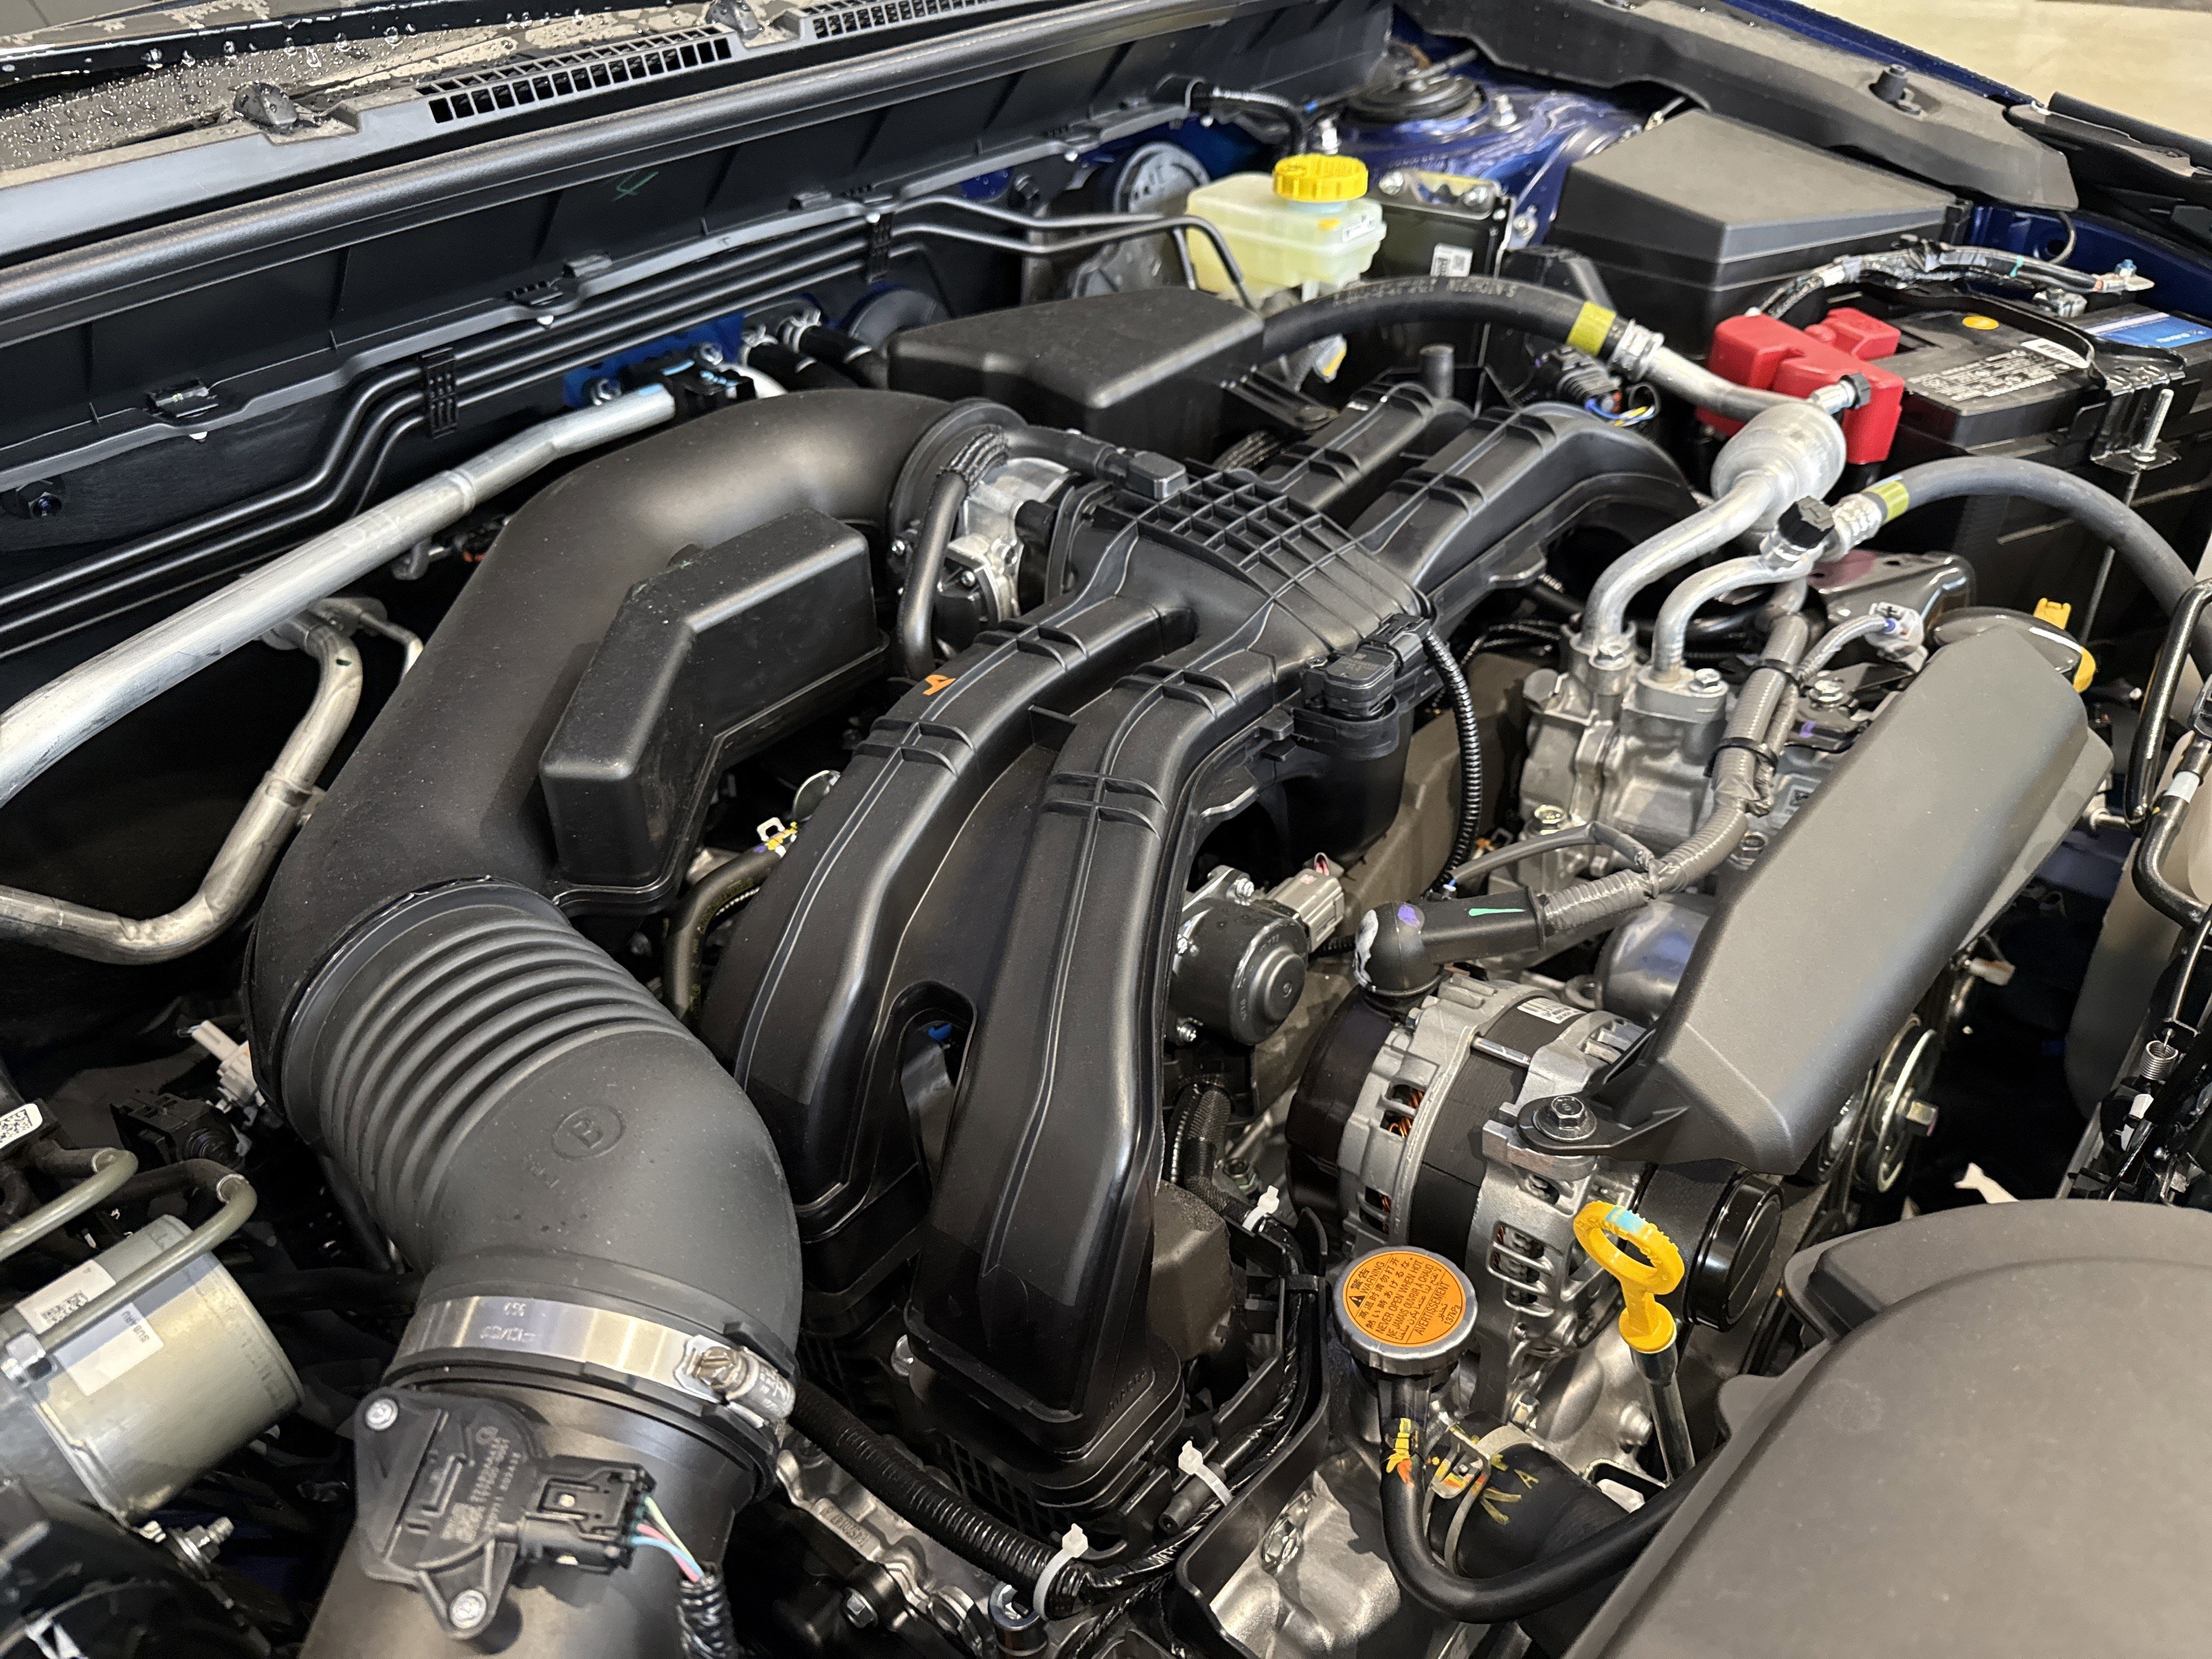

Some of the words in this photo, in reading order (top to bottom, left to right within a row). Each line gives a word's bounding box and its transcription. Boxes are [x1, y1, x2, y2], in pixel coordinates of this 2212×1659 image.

[571, 1118, 603, 1149] B
[1350, 1268, 1370, 1290] 警告
[1358, 1257, 1399, 1319] 高温时请勿打开
[1359, 1261, 1385, 1294] WARNING
[1375, 1312, 1394, 1334] NEVER
[1388, 1293, 1404, 1311] OPEN
[1398, 1273, 1415, 1293] WHEN
[1386, 1328, 1398, 1338] NE
[1392, 1308, 1409, 1329] JAMAIS
[1403, 1288, 1421, 1308] OUVRIR
[1414, 1280, 1449, 1335] AVERTISSEMENT
[1443, 1304, 1462, 1325] 137kPa
